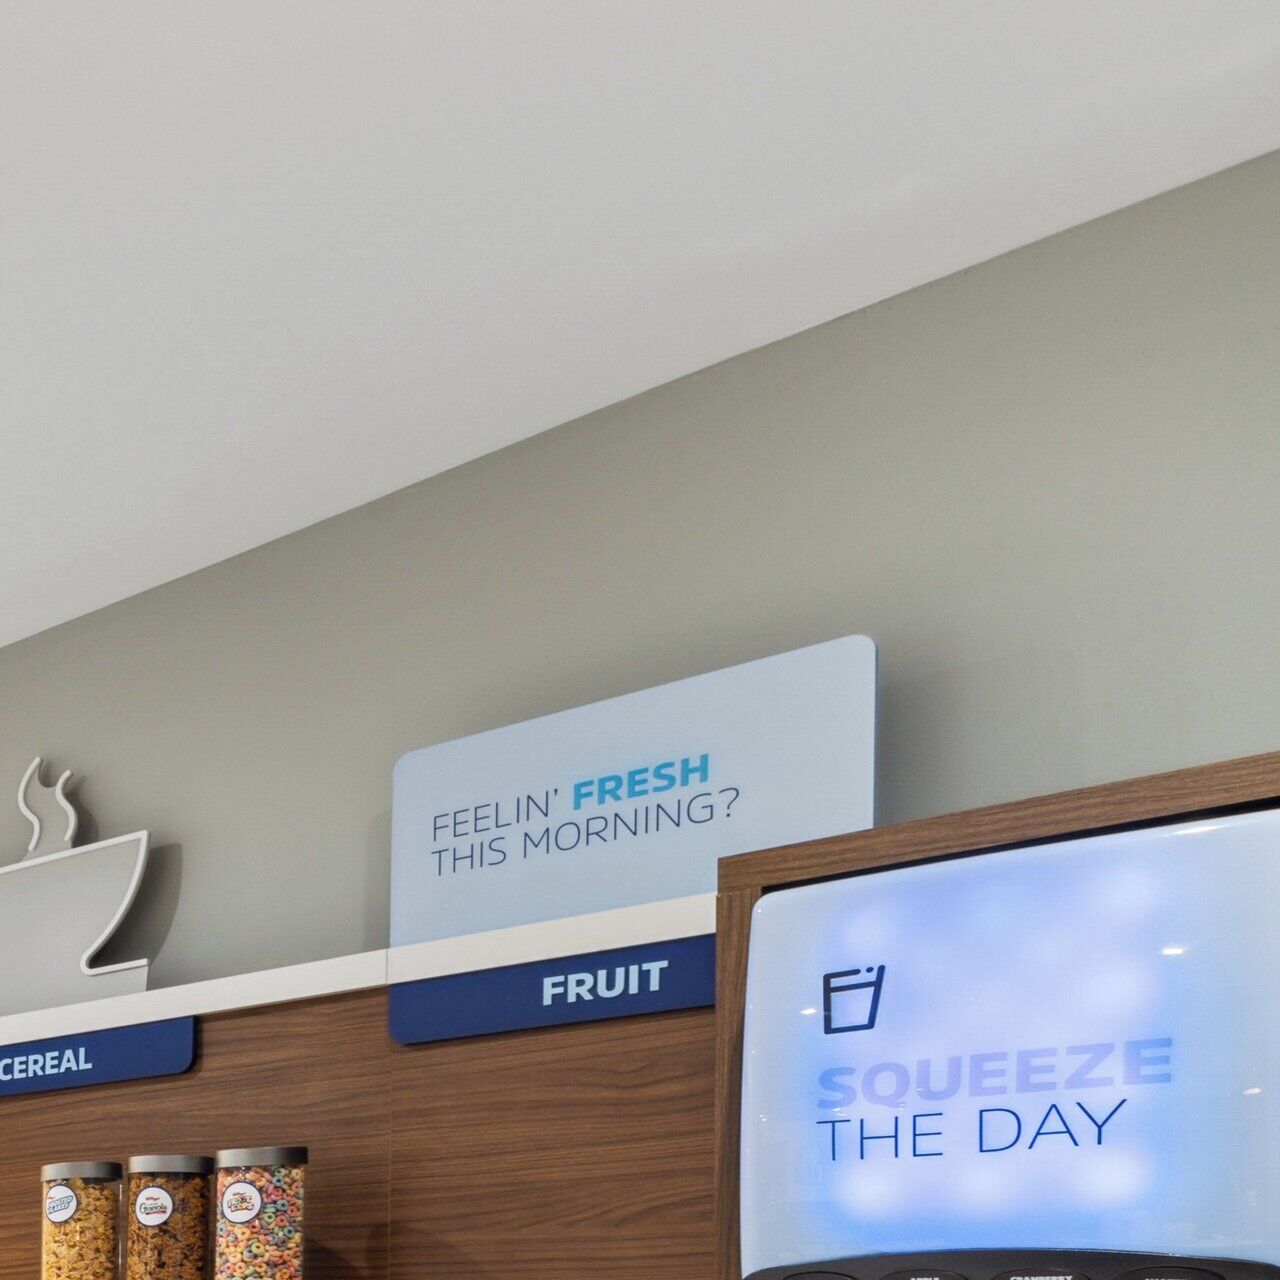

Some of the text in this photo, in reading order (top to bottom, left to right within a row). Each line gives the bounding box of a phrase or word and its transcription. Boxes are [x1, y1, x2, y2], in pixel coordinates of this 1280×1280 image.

[431, 787, 740, 877] THIS MORNING?
[432, 753, 710, 843] FEELIN' FRESH
[542, 960, 669, 1007] FRUIT
[816, 1037, 1173, 1110] SQUEEZE
[816, 1098, 1128, 1161] THE DAY
